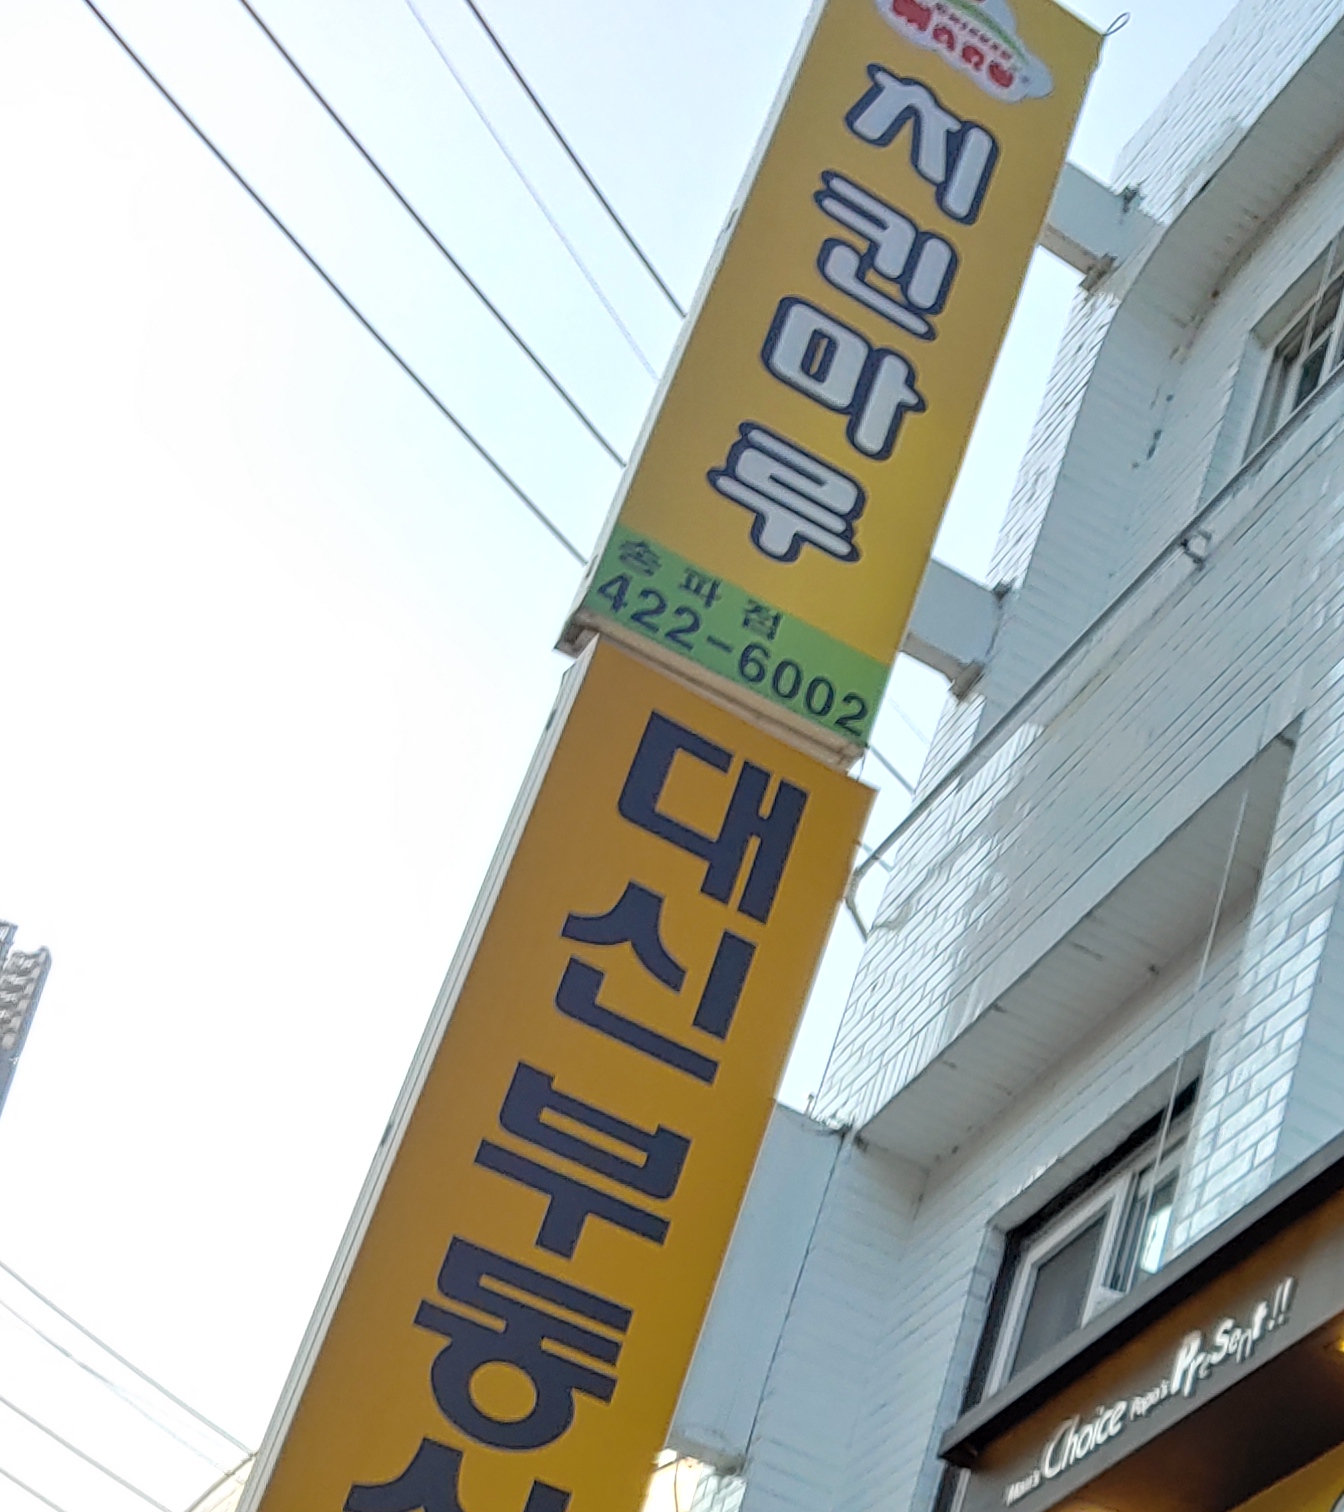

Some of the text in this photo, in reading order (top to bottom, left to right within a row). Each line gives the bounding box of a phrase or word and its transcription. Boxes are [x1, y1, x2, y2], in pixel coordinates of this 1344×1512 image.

[706, 62, 1000, 563] 치킨마루
[597, 572, 869, 737] 422-6002
[1042, 1401, 1128, 1478] Choice
